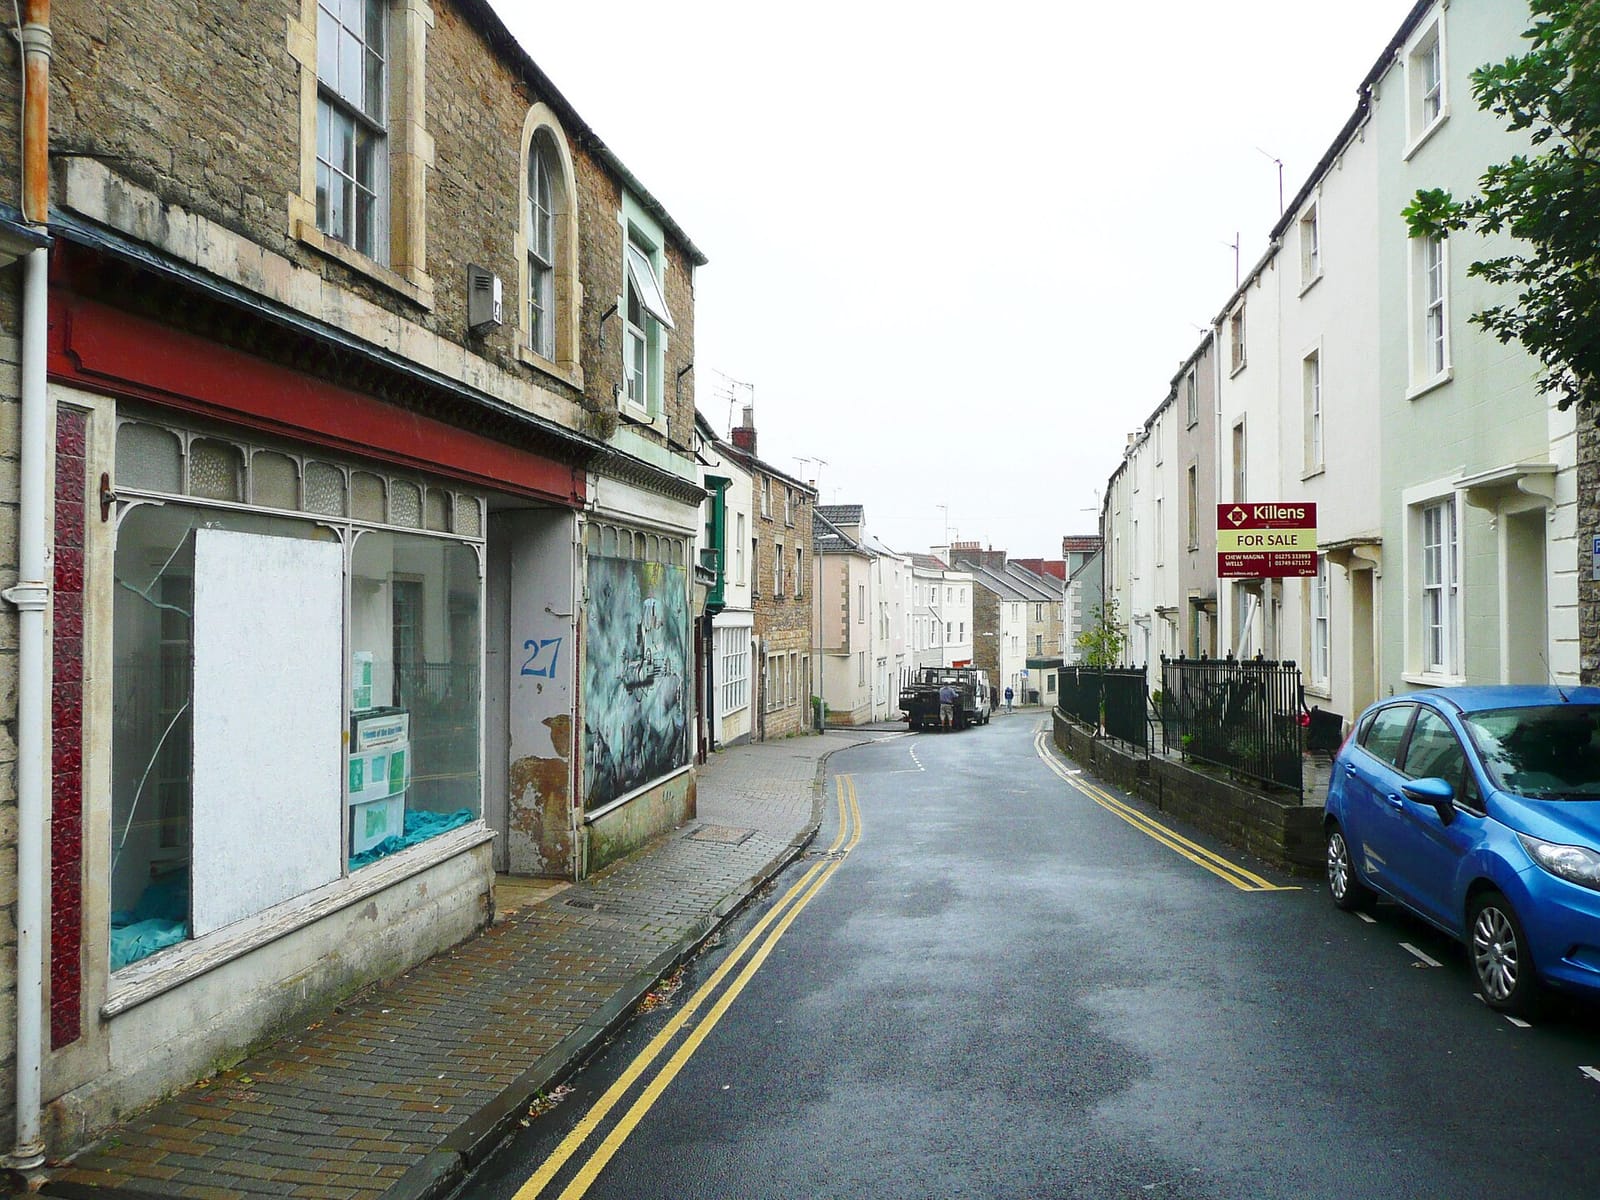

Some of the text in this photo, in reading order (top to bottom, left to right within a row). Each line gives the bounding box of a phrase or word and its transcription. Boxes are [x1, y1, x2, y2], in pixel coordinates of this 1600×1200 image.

[1253, 505, 1305, 519] Killens
[1237, 535, 1298, 546] FOR SALE
[520, 637, 562, 678] 27
